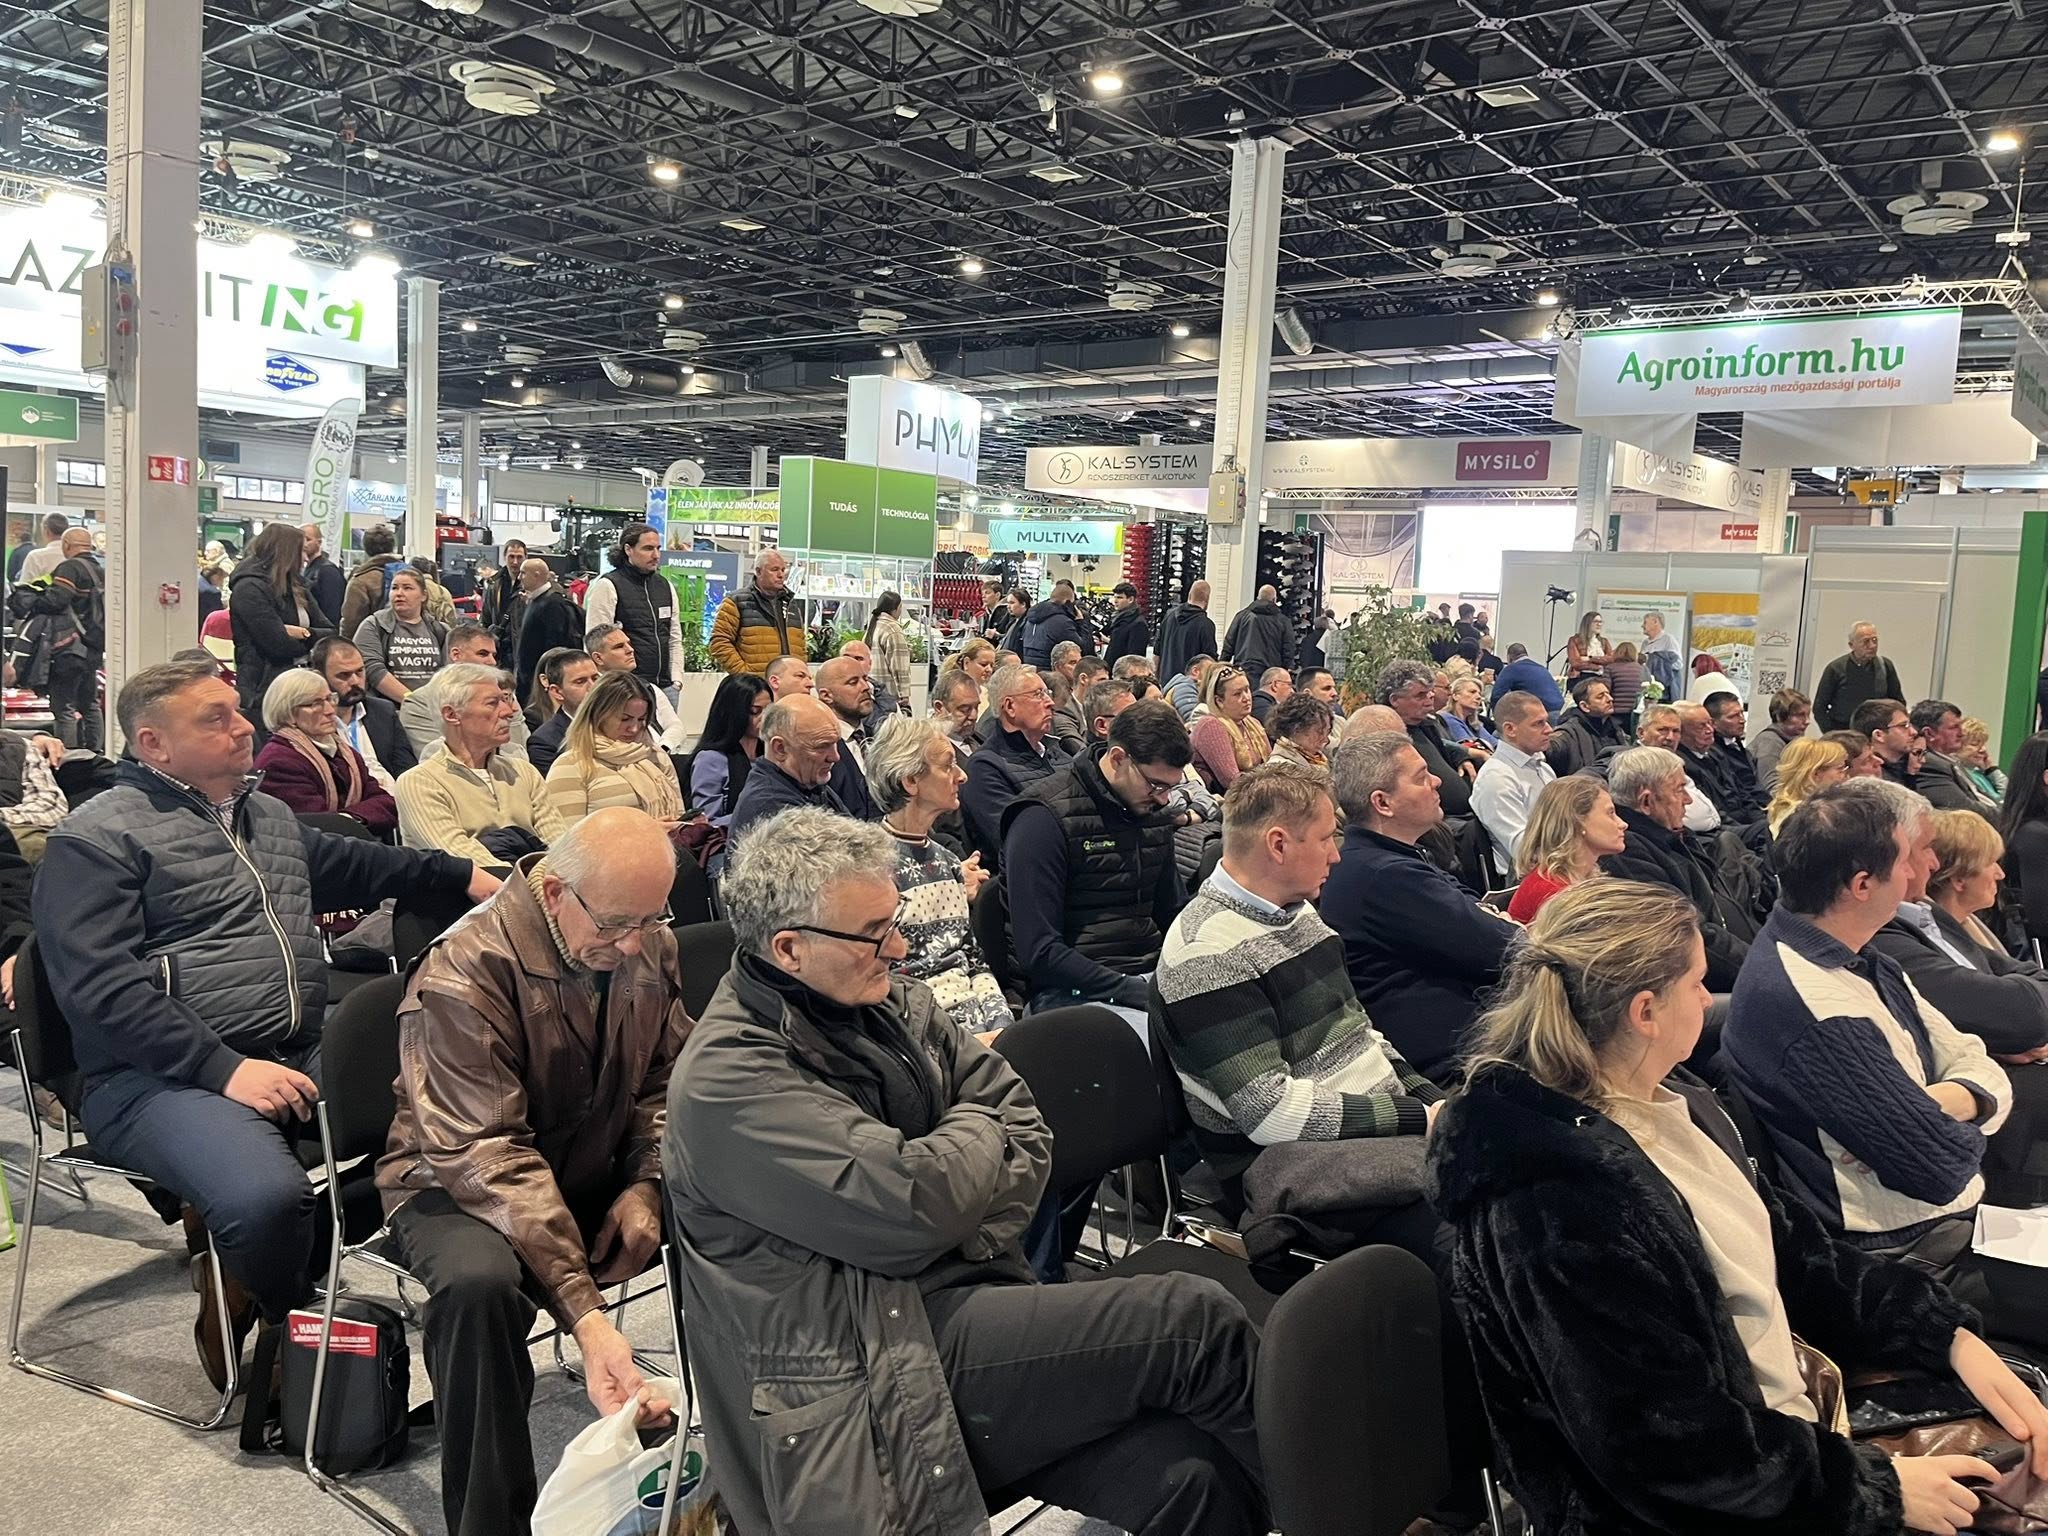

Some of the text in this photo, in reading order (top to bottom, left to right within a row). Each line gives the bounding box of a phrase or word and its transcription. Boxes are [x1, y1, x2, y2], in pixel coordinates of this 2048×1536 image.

[1616, 338, 1905, 391] Agroinform.hu
[1695, 376, 1901, 397] Magyarország mezőgazdasági portálja
[1088, 454, 1198, 470] KAL-SYSTEM
[1151, 472, 1197, 480] ALKOTUNK
[829, 501, 858, 513] TUDÁS
[881, 508, 930, 521] TECHNOLÓGIA
[1017, 529, 1090, 544] MULTIVA
[394, 636, 432, 646] NAGYON
[397, 656, 432, 666] VAGY!
